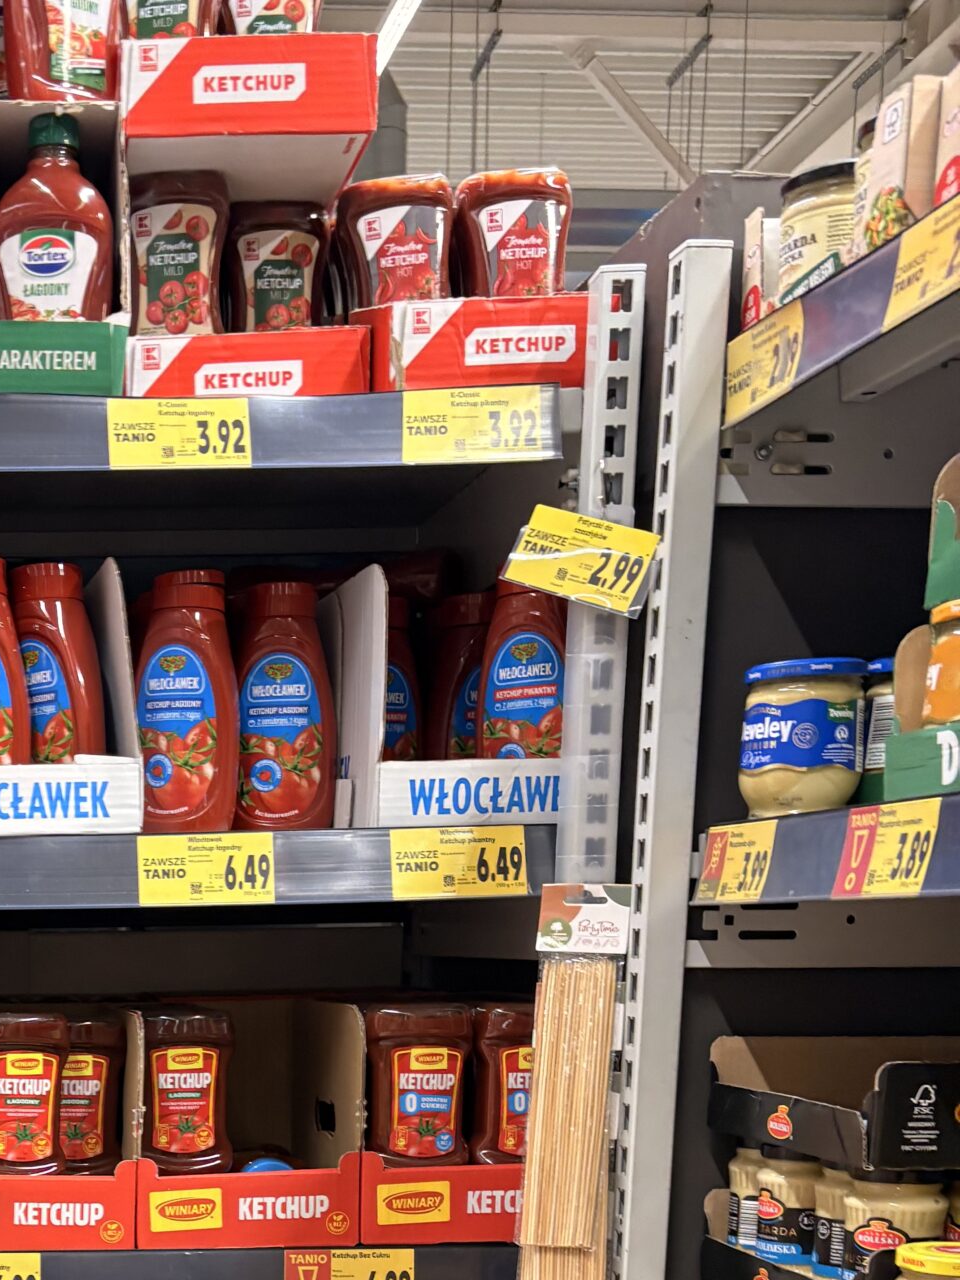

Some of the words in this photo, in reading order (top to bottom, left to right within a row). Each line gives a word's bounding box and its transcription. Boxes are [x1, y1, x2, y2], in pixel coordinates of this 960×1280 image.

[25, 250, 68, 263] Tortex
[474, 335, 567, 354] KETCHUP
[203, 370, 294, 389] KETCHUP
[113, 422, 156, 431] ZAWSZE
[406, 414, 448, 424] ZAWSZE
[488, 409, 538, 448] 3.92
[114, 432, 156, 443] TANIO
[197, 419, 246, 455] 3.92
[406, 425, 449, 437] TANIO
[588, 547, 643, 595] 2.99
[498, 663, 553, 681] WŁOCŁAWEK
[251, 682, 307, 698] WŁOCŁAWEK
[409, 775, 560, 816] WŁOCŁAW
[477, 846, 522, 882] 6.49
[890, 829, 931, 881] 3.89
[143, 868, 187, 879] TANIO
[223, 853, 271, 891] 6.49
[163, 1203, 214, 1217] WINIARY
[238, 1195, 330, 1221] KETCHUP
[391, 1195, 442, 1210] WINIARY
[467, 1189, 524, 1214] KETCH
[13, 1202, 104, 1226] KETCHUP
[289, 1254, 328, 1265] TANIO
